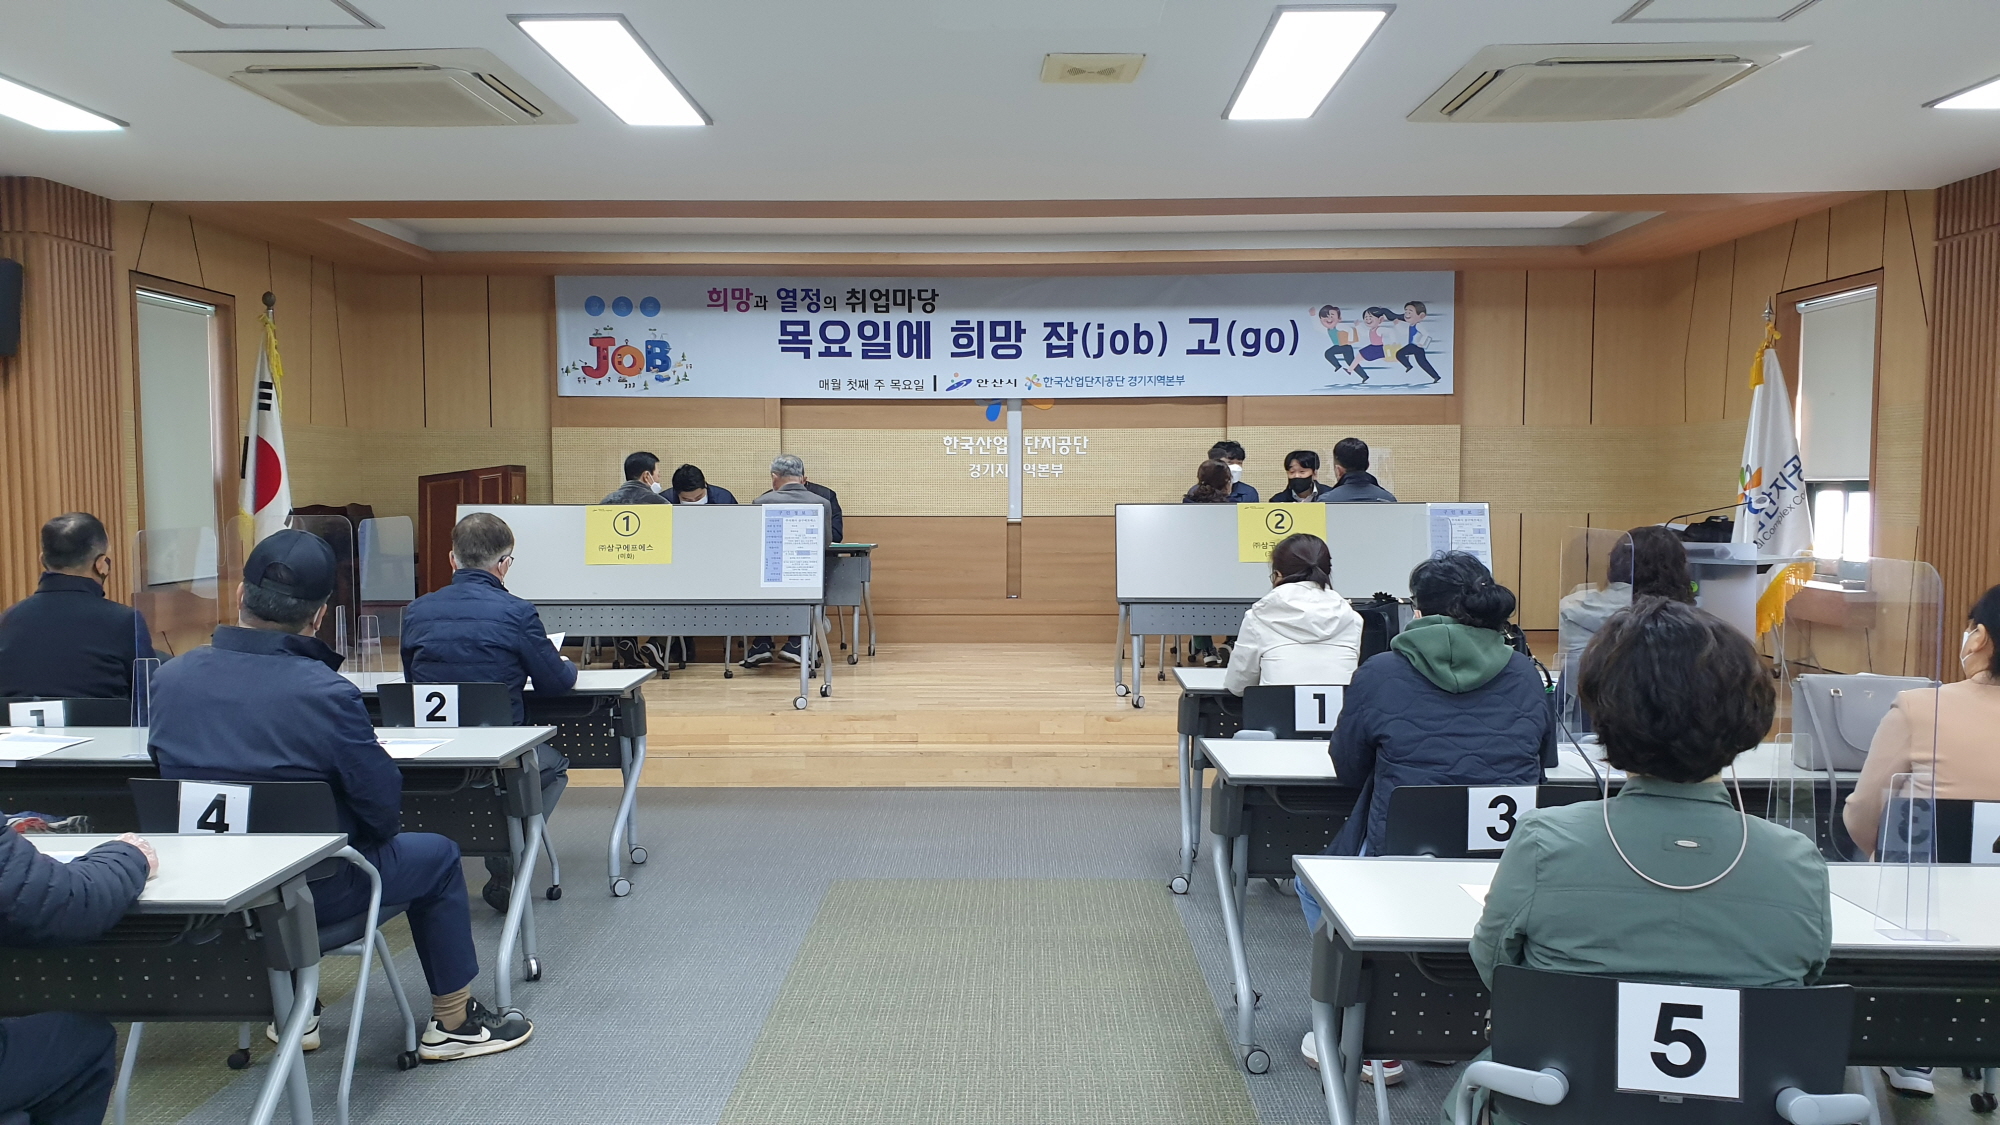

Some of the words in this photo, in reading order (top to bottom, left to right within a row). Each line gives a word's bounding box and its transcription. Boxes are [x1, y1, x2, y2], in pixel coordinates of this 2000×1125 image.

[707, 287, 768, 312] 희망과
[776, 288, 837, 313] 열정의
[845, 288, 939, 313] 취업마당
[778, 320, 931, 359] 목요일에
[950, 320, 1027, 360] 희망
[1042, 320, 1168, 359] 잡(job)
[1185, 317, 1300, 357] 고(go)
[581, 336, 673, 379] JOB
[818, 379, 841, 391] 매월
[847, 379, 869, 391] 첫째
[874, 379, 885, 391] 주
[890, 379, 924, 391] 목요일
[976, 378, 1018, 388] 안산시
[1043, 375, 1126, 388] 한국산업단지공단
[1127, 374, 1186, 387] 경기지역본부
[424, 691, 447, 722] 2
[1312, 692, 1326, 724] 1
[196, 793, 230, 833] 4
[1486, 794, 1518, 842] 3
[1650, 1002, 1707, 1079] 5
